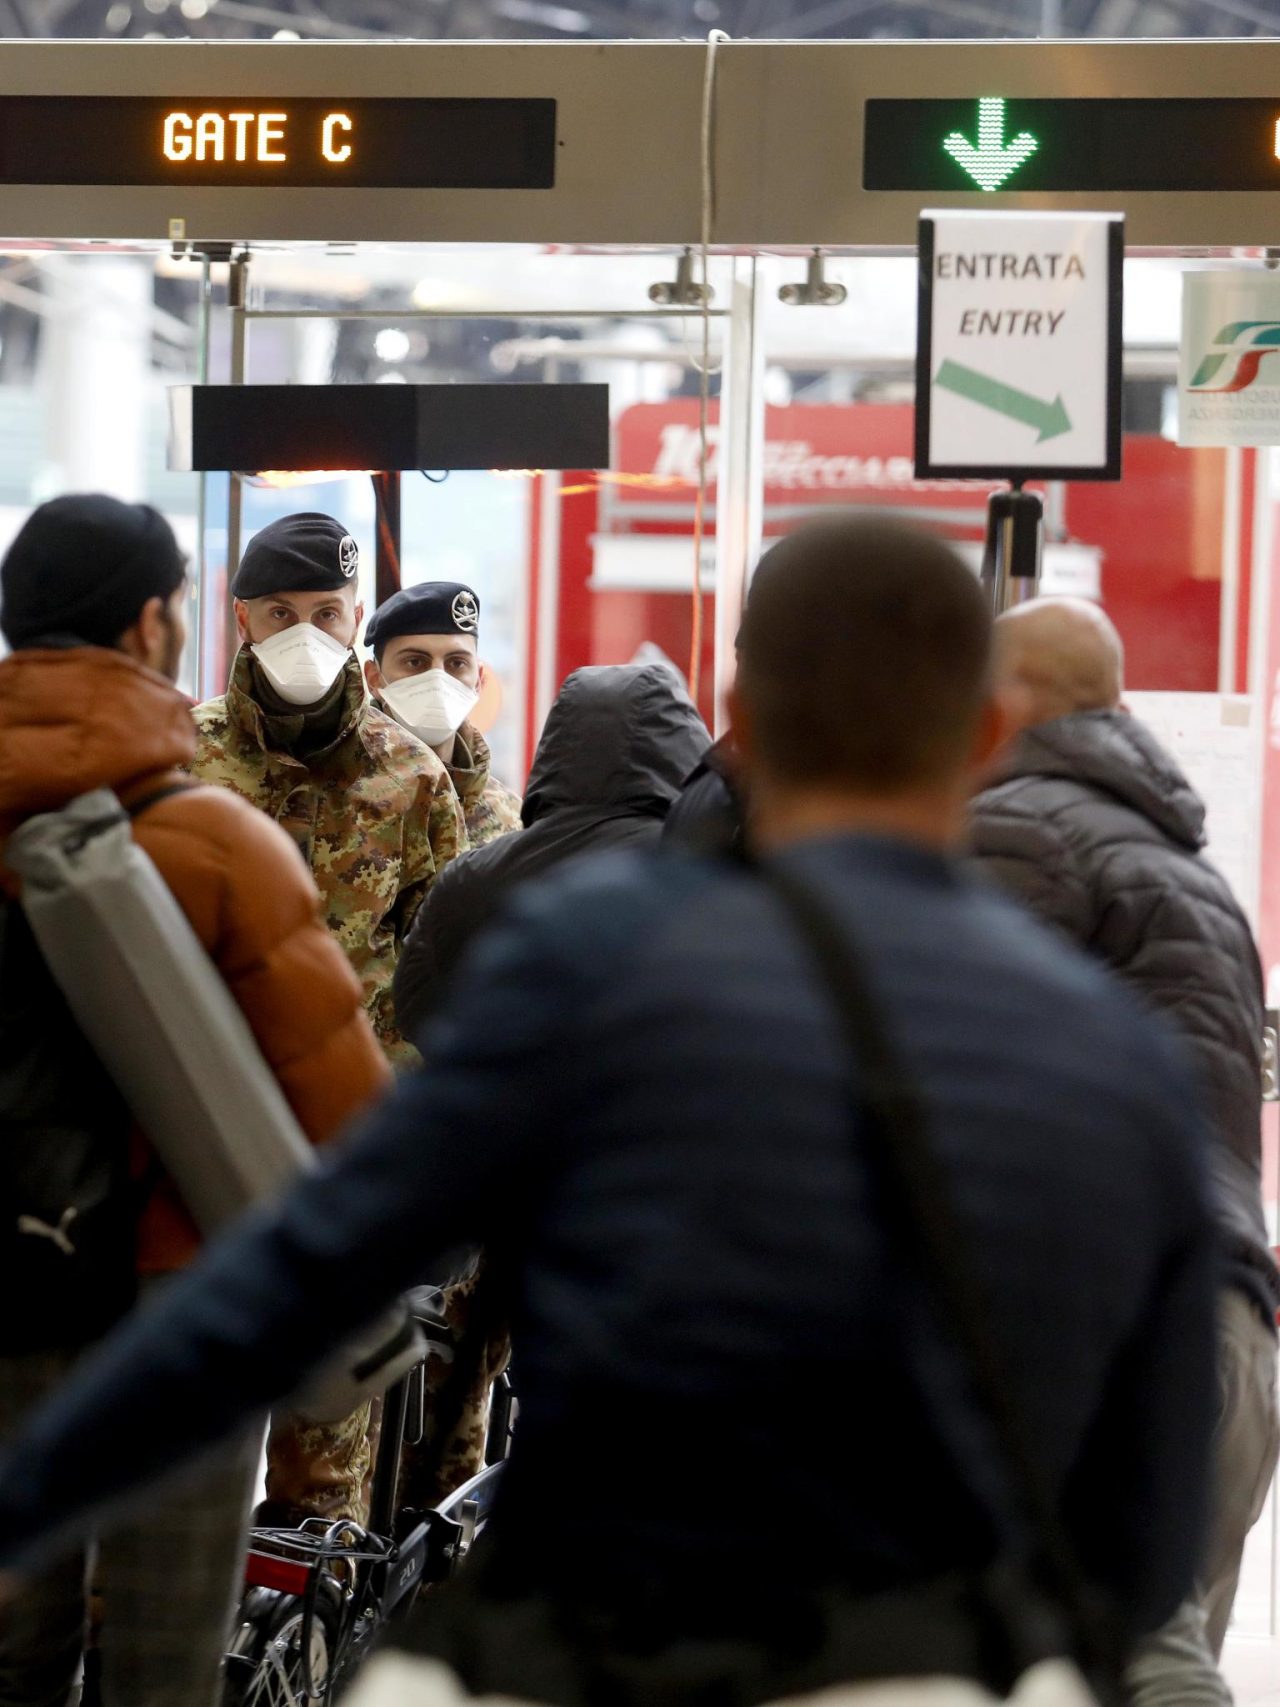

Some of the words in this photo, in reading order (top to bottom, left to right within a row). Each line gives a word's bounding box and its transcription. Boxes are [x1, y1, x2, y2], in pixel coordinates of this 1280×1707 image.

[163, 112, 288, 162] GATE
[322, 113, 353, 163] C
[936, 253, 1085, 280] ENTRATA
[959, 310, 1066, 336] ENTRY
